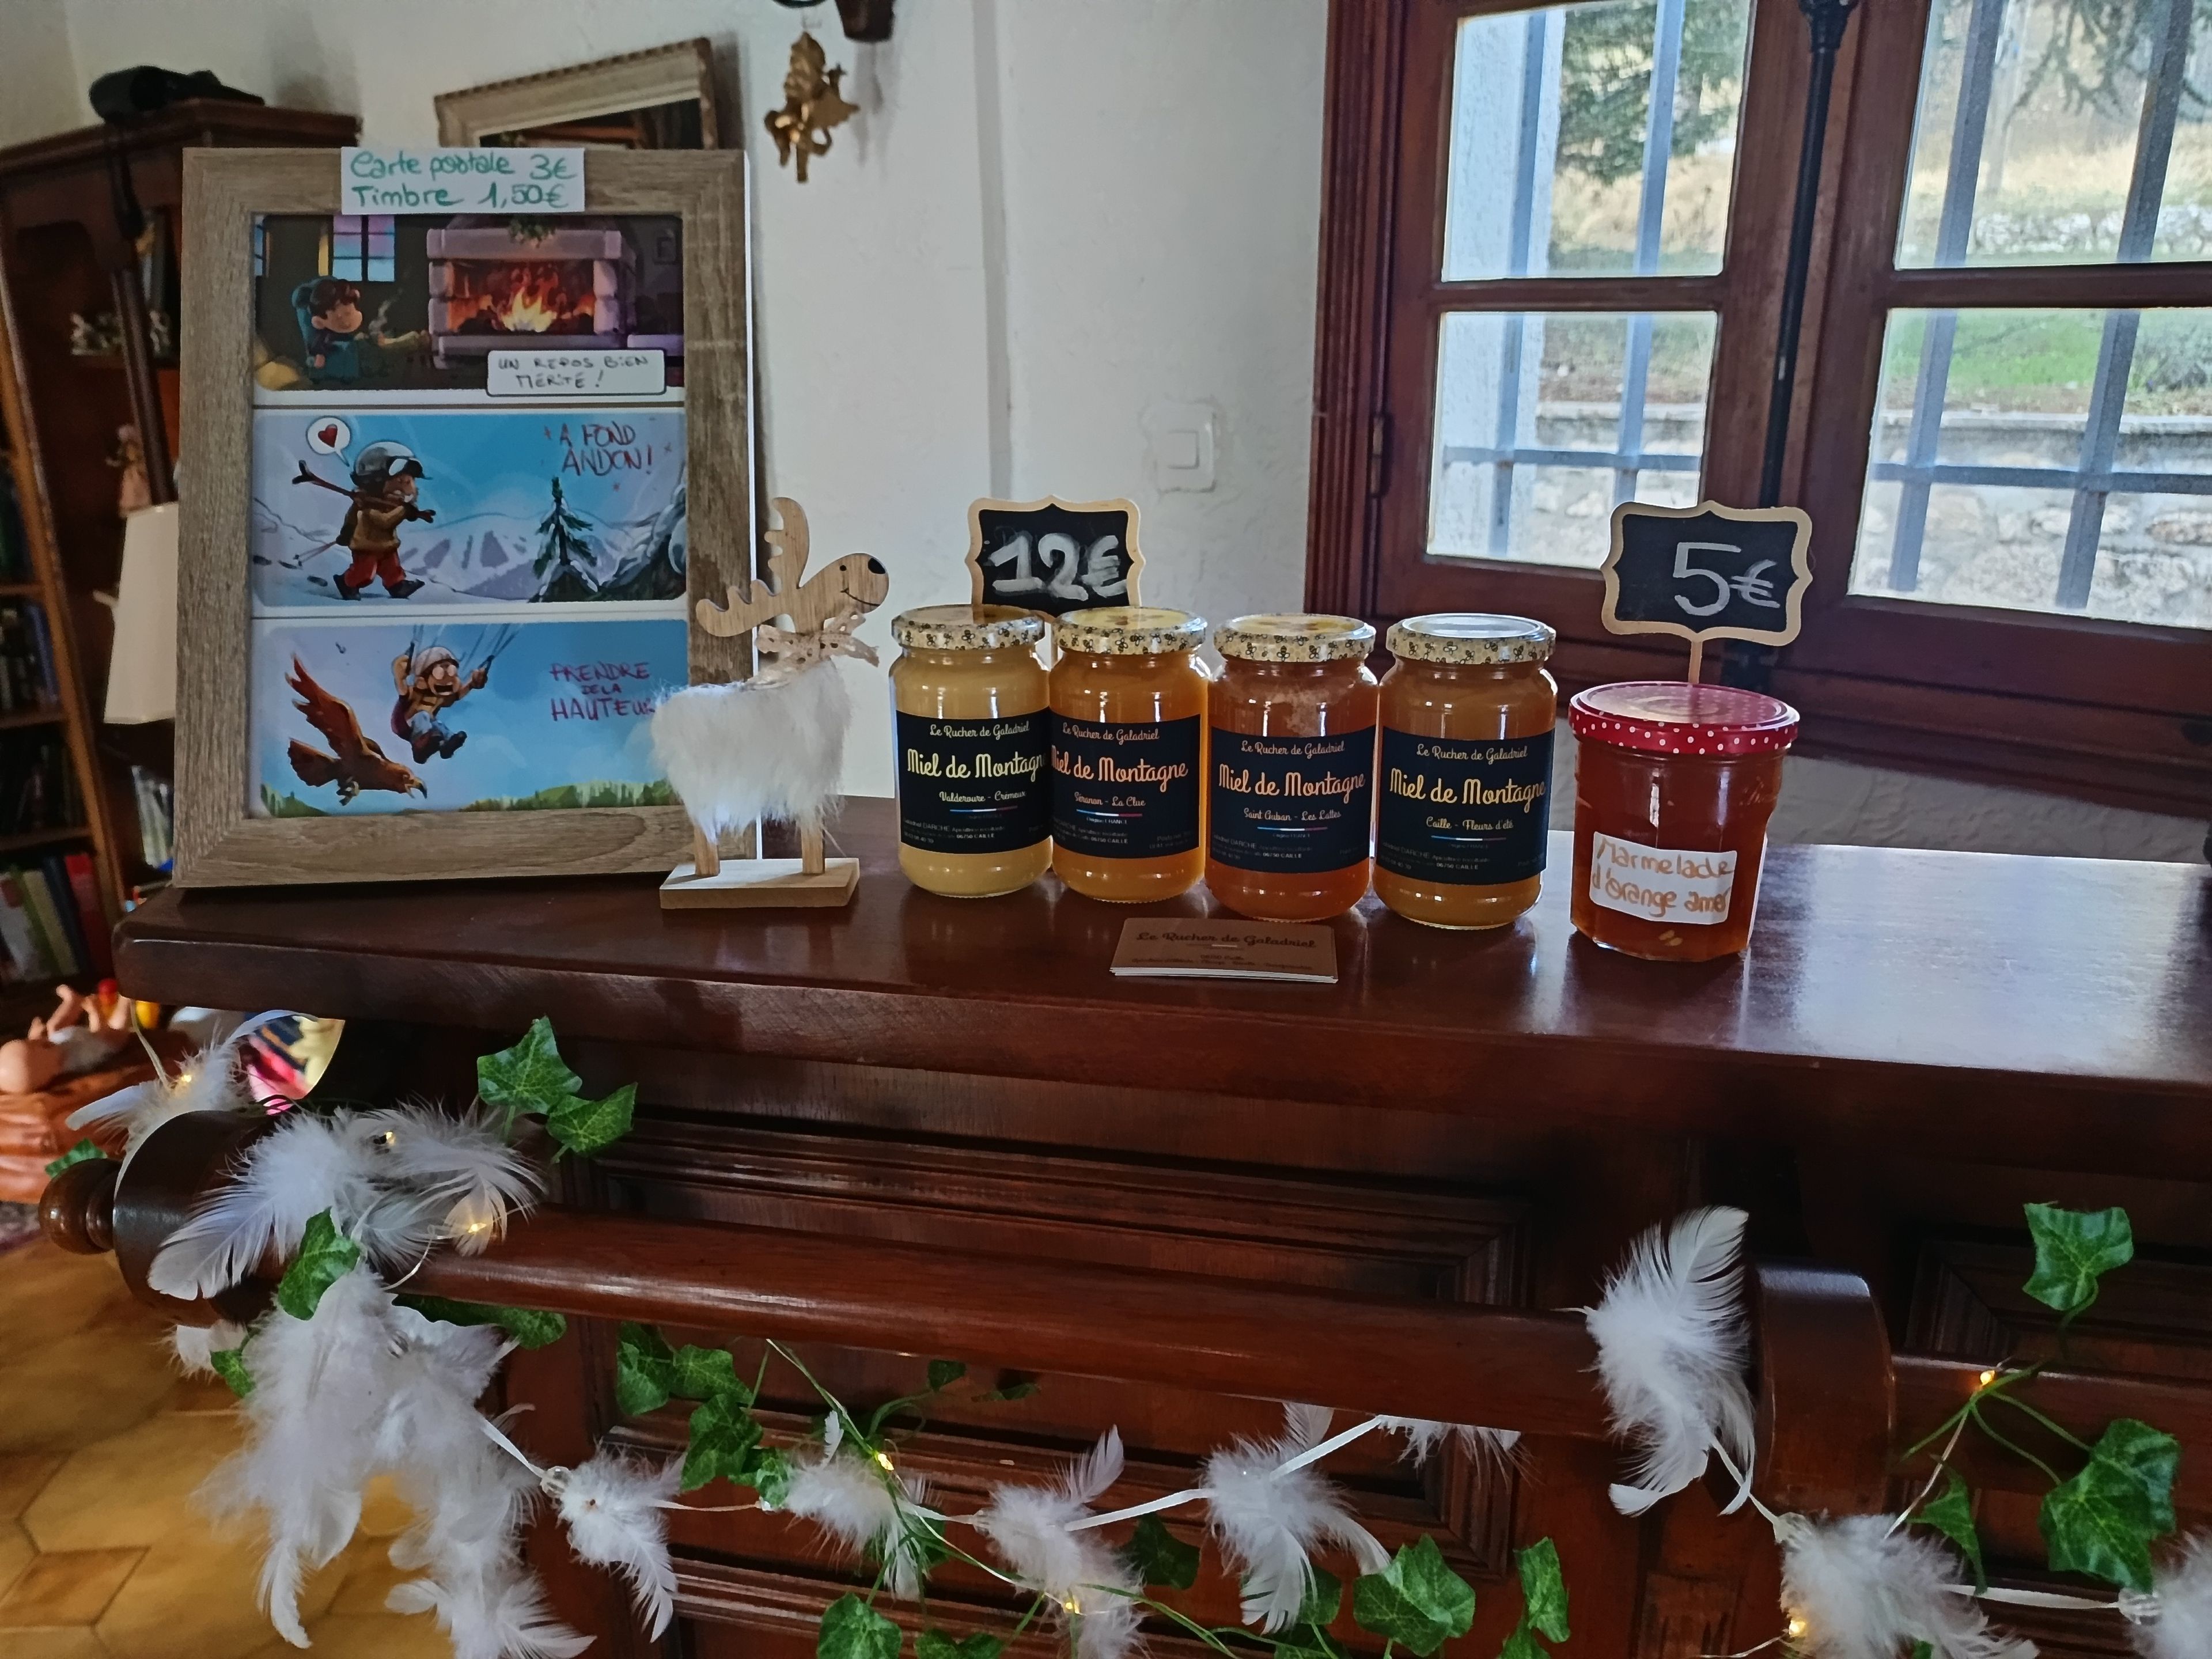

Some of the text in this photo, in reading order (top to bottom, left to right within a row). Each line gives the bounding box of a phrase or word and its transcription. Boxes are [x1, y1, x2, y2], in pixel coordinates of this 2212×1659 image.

[350, 150, 577, 181] Carte postale 3€
[351, 181, 568, 209] Timbre 1,50€
[498, 358, 520, 370] UN
[534, 357, 593, 369] REPOS
[582, 421, 636, 447] FOND
[988, 531, 1127, 601] 12€
[1673, 542, 1780, 616] 5€
[549, 661, 651, 682] PRENDRE
[930, 721, 1030, 740] Le Rucher de Galadriel
[1062, 722, 1160, 745] Le Rucher de Galadriel
[1241, 740, 1344, 759] Le Rucher de Galadriel
[1416, 744, 1528, 765] Le Rucher de Galadriel
[907, 748, 942, 777] Miel
[946, 755, 971, 778] de
[1074, 755, 1094, 779] de
[1098, 757, 1188, 792] Montagne
[1218, 763, 1366, 804] Miel de Montagne
[1389, 768, 1546, 813] Miel de Montagne
[939, 791, 986, 802] Valderoure
[994, 790, 1026, 801] Crémeux
[1112, 796, 1124, 806] La
[1244, 808, 1263, 820] Saint
[1301, 811, 1317, 821] Les
[1319, 809, 1342, 820] Lattes
[1426, 816, 1452, 829] Caille
[1462, 819, 1494, 831] Fleurs
[1596, 838, 1733, 878] Marmelade
[1136, 931, 1158, 941] Le
[1162, 931, 1218, 942] Rucher
[1221, 934, 1240, 942] de
[1244, 935, 1316, 948] Galadriel
